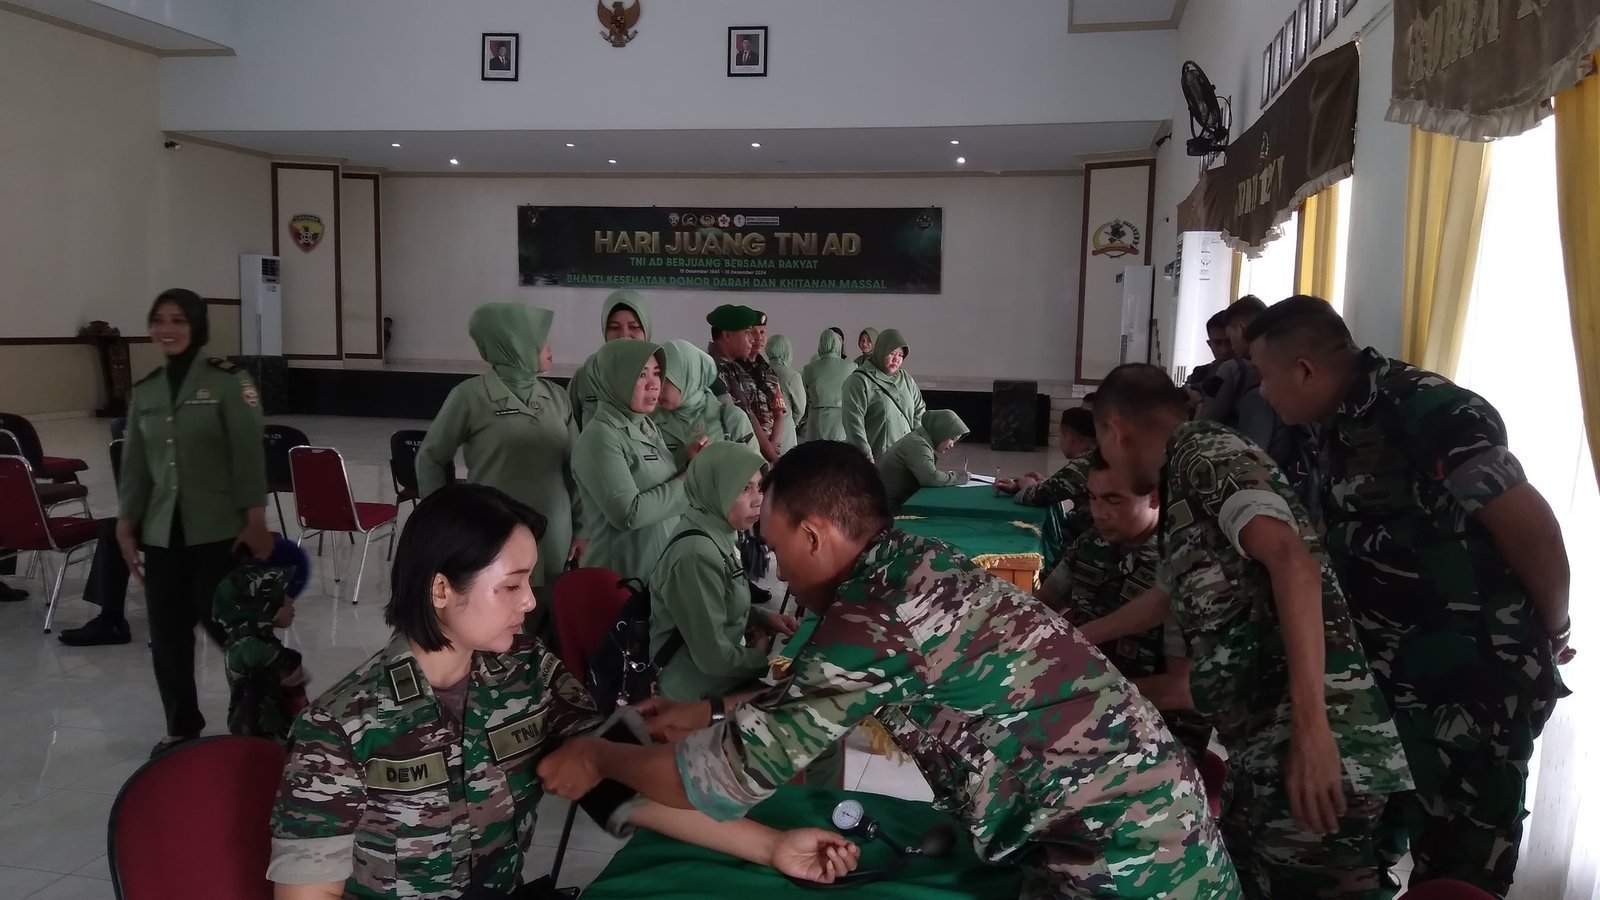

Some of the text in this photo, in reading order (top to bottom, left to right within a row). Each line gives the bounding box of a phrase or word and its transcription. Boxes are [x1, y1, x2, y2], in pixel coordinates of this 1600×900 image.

[594, 231, 862, 256] HARI JUANG TNI AD
[630, 257, 819, 269] TNI AD BERJUANG BERSAMA RAKYAT
[566, 274, 887, 290] BHAKTI KESEHATAN DONOR DARAH DAN KHITANAN MASSAL
[511, 723, 539, 744] TNI
[386, 763, 429, 783] DEWI
